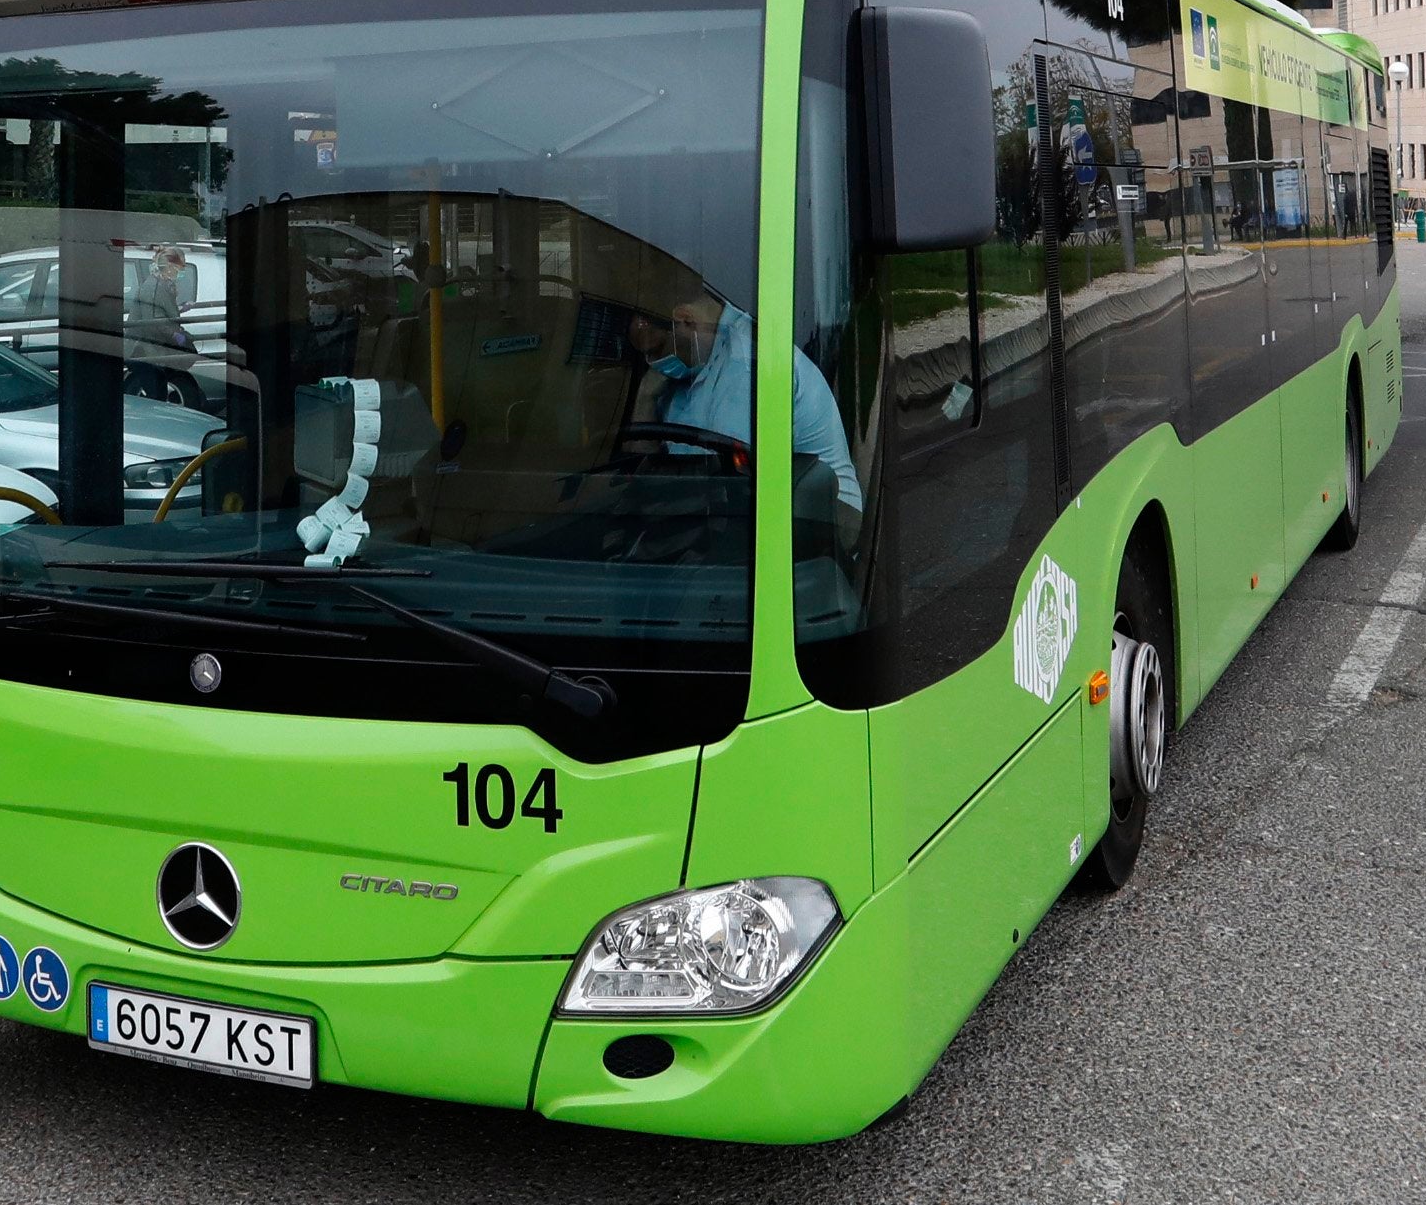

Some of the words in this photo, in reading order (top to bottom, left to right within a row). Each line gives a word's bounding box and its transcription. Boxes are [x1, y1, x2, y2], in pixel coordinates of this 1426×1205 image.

[442, 762, 563, 834] 104
[339, 873, 459, 901] CITARO
[96, 1019, 104, 1032] E
[116, 998, 211, 1054] 6057
[227, 1017, 301, 1071] KST
